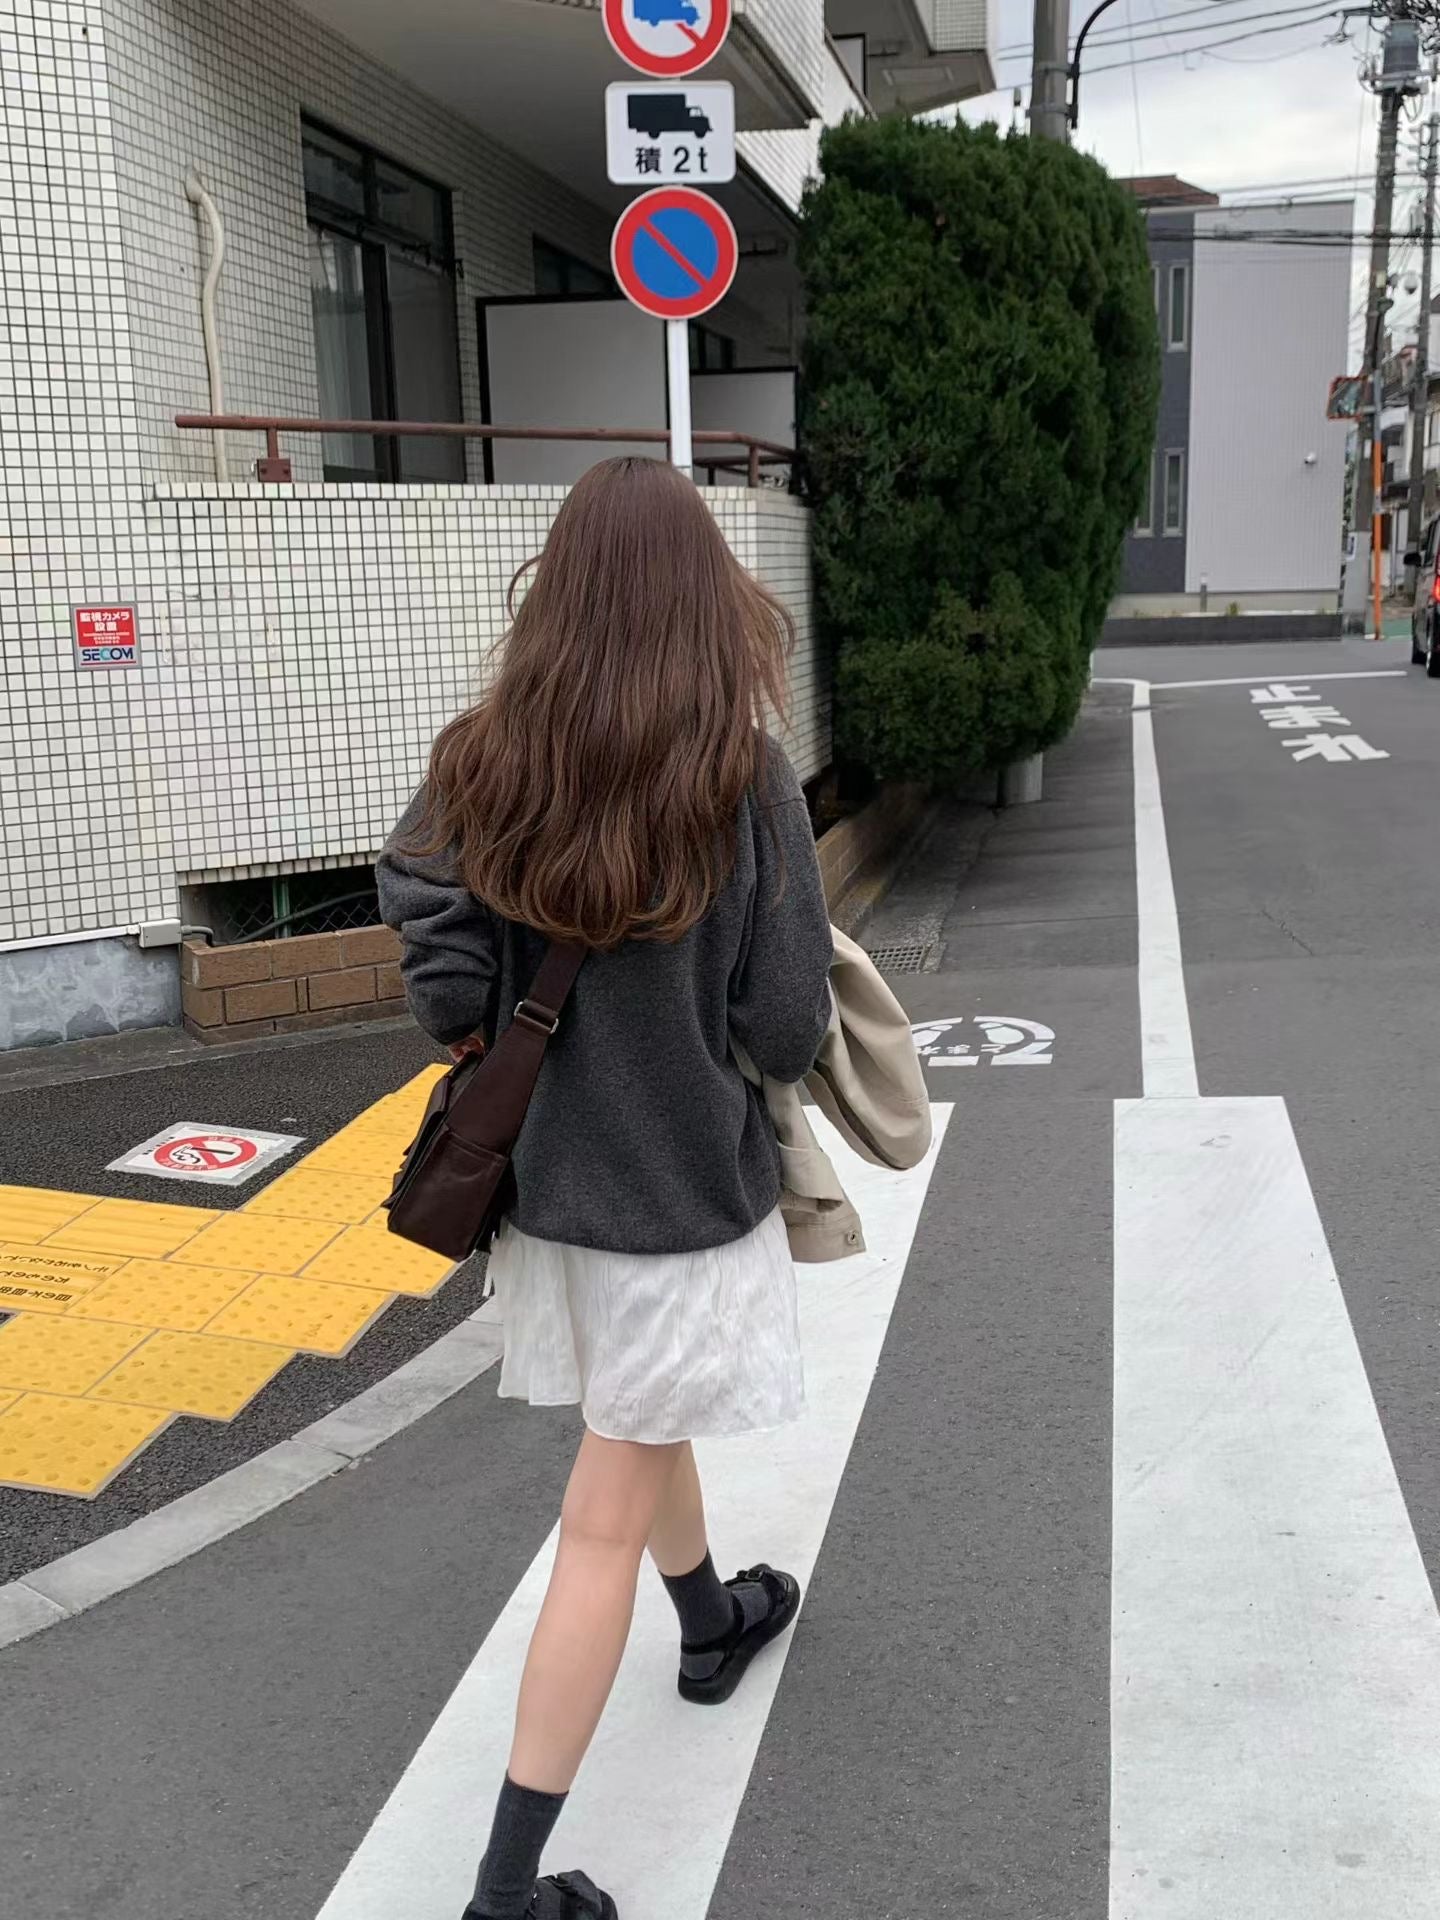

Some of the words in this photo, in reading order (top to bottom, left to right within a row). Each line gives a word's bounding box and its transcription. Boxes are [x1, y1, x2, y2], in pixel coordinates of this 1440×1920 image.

[94, 621, 117, 632] 設置
[82, 647, 134, 661] SECOM
[1250, 684, 1391, 762] 止まれ
[0, 1254, 110, 1273] モノをおかないで
